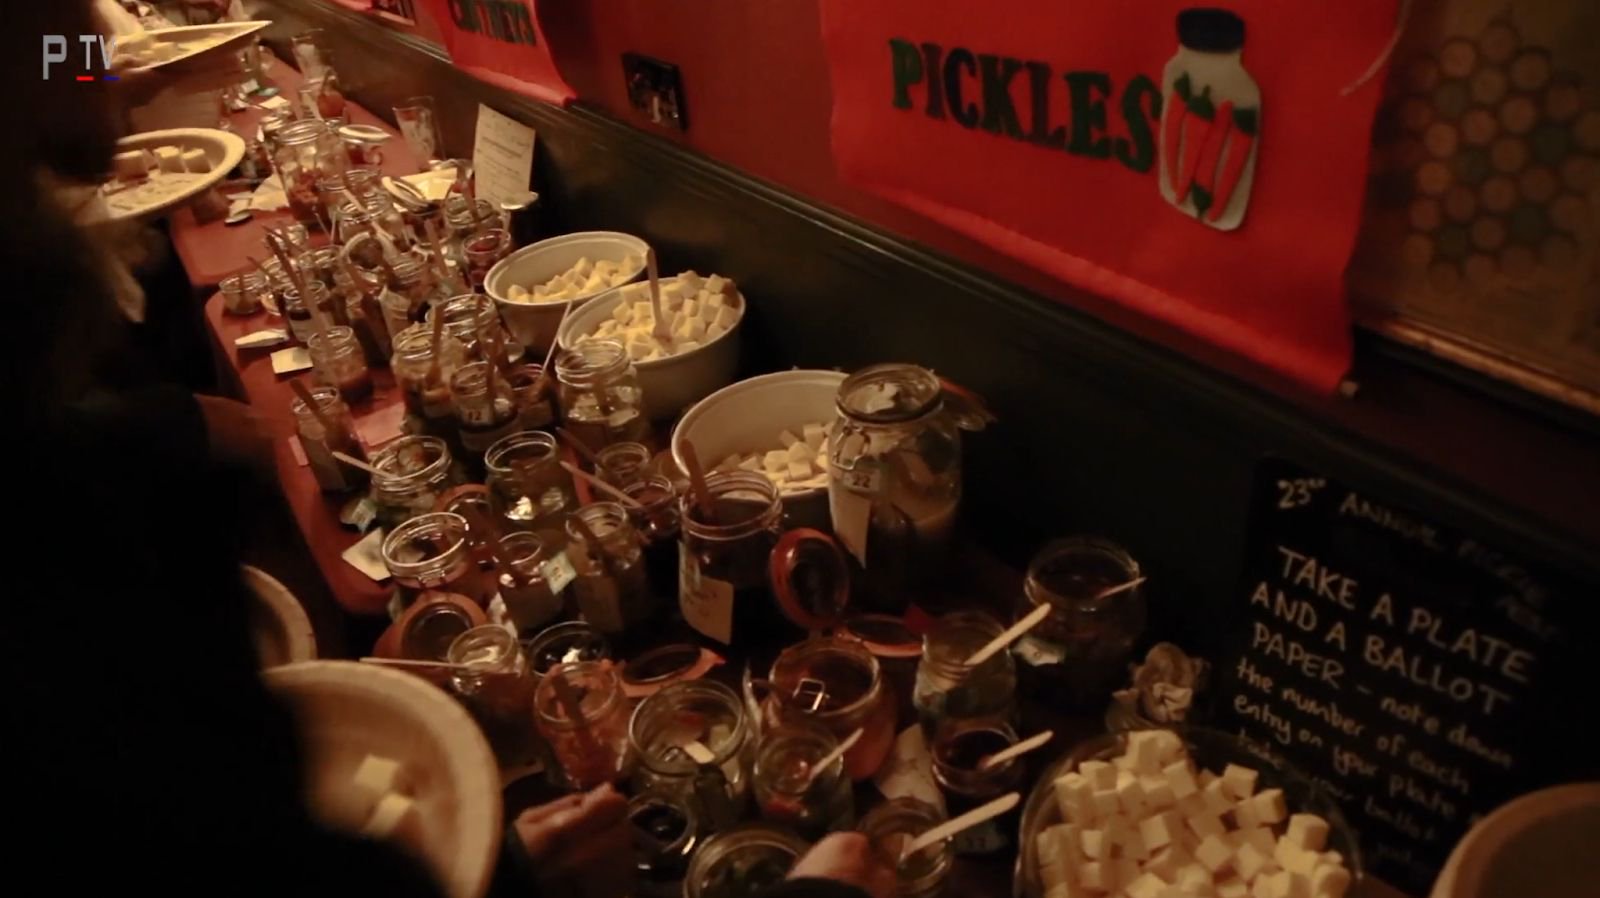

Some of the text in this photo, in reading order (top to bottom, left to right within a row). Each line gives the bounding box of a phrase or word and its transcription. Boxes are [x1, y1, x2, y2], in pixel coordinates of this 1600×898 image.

[889, 38, 1162, 174] PICKLES
[1250, 580, 1514, 716] AND A BALLOT
[1252, 621, 1345, 690] PAPER
[1379, 696, 1441, 736] note
[1277, 545, 1360, 611] TAKE
[1369, 592, 1395, 627] A
[1406, 606, 1536, 685] PLATE
[1233, 694, 1293, 746] entry
[1299, 728, 1324, 748] on
[1235, 656, 1471, 796] the number of each
